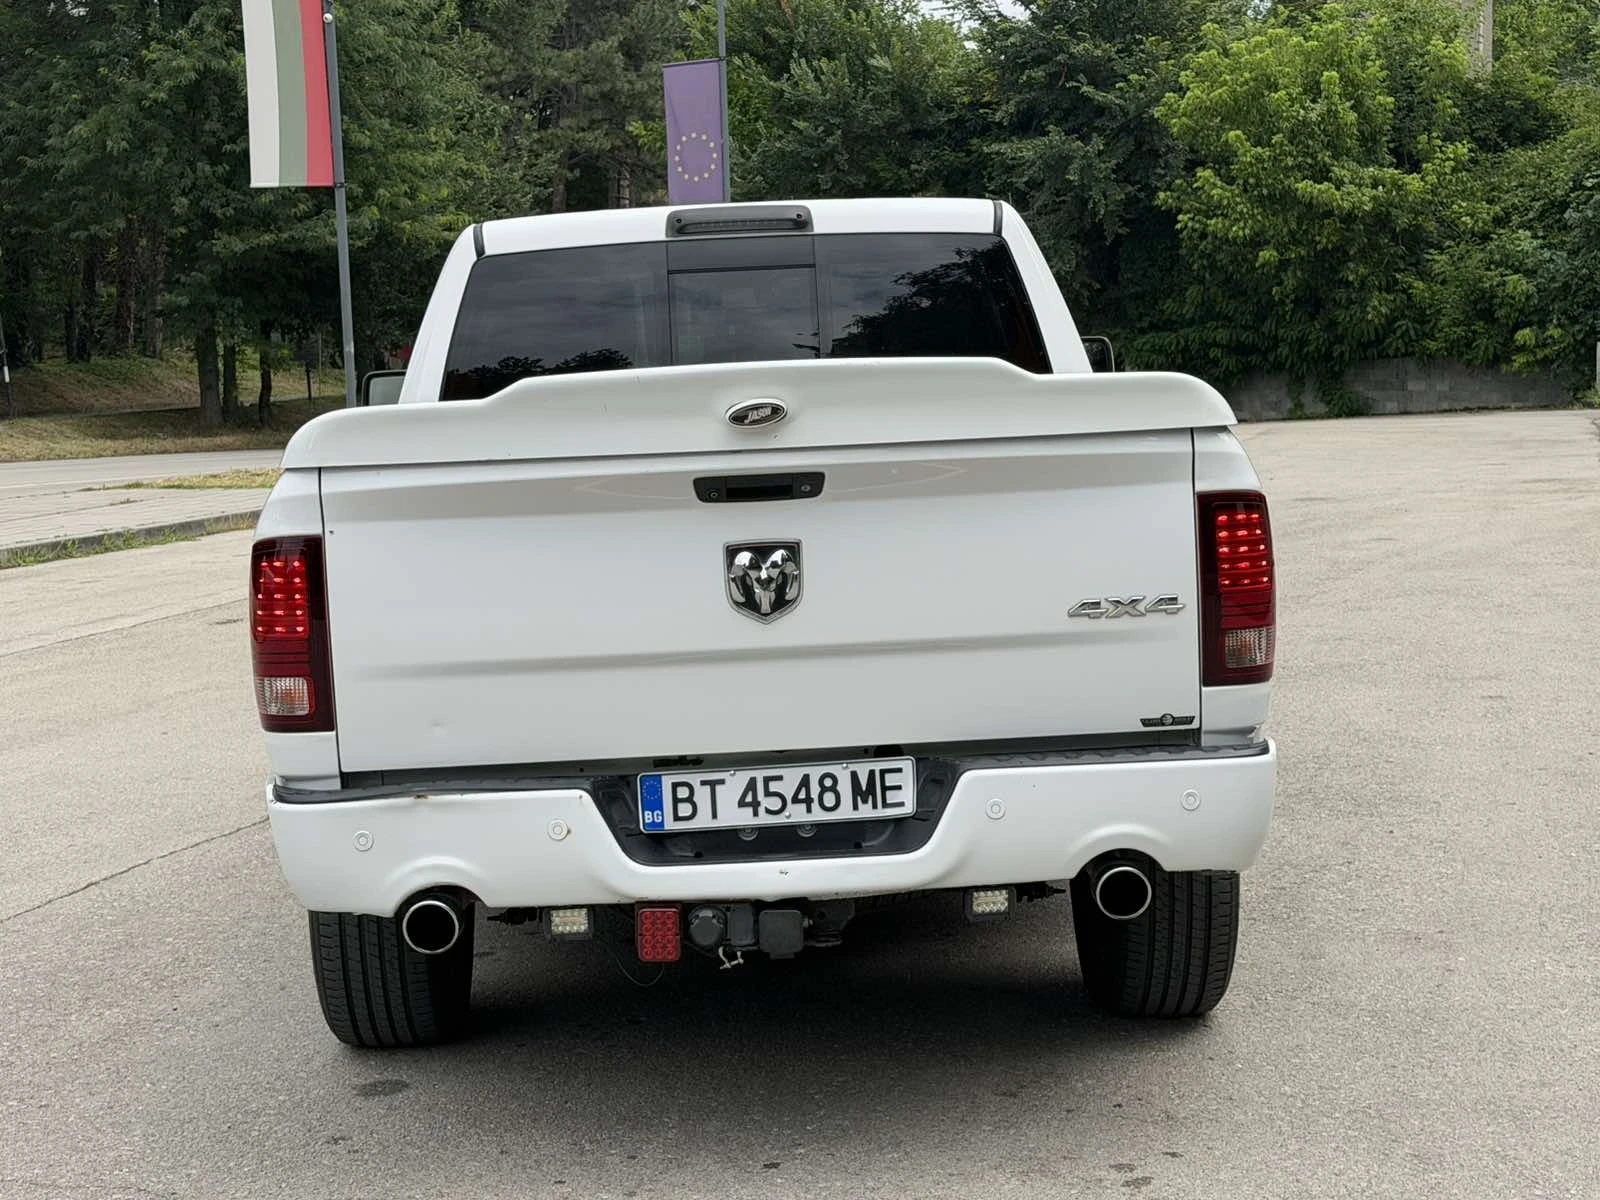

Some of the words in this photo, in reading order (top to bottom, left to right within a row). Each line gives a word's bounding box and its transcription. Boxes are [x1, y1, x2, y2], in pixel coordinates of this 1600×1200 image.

[670, 778, 726, 822] BT
[737, 772, 842, 817] 4548
[849, 767, 905, 811] ME
[644, 809, 662, 823] BG
